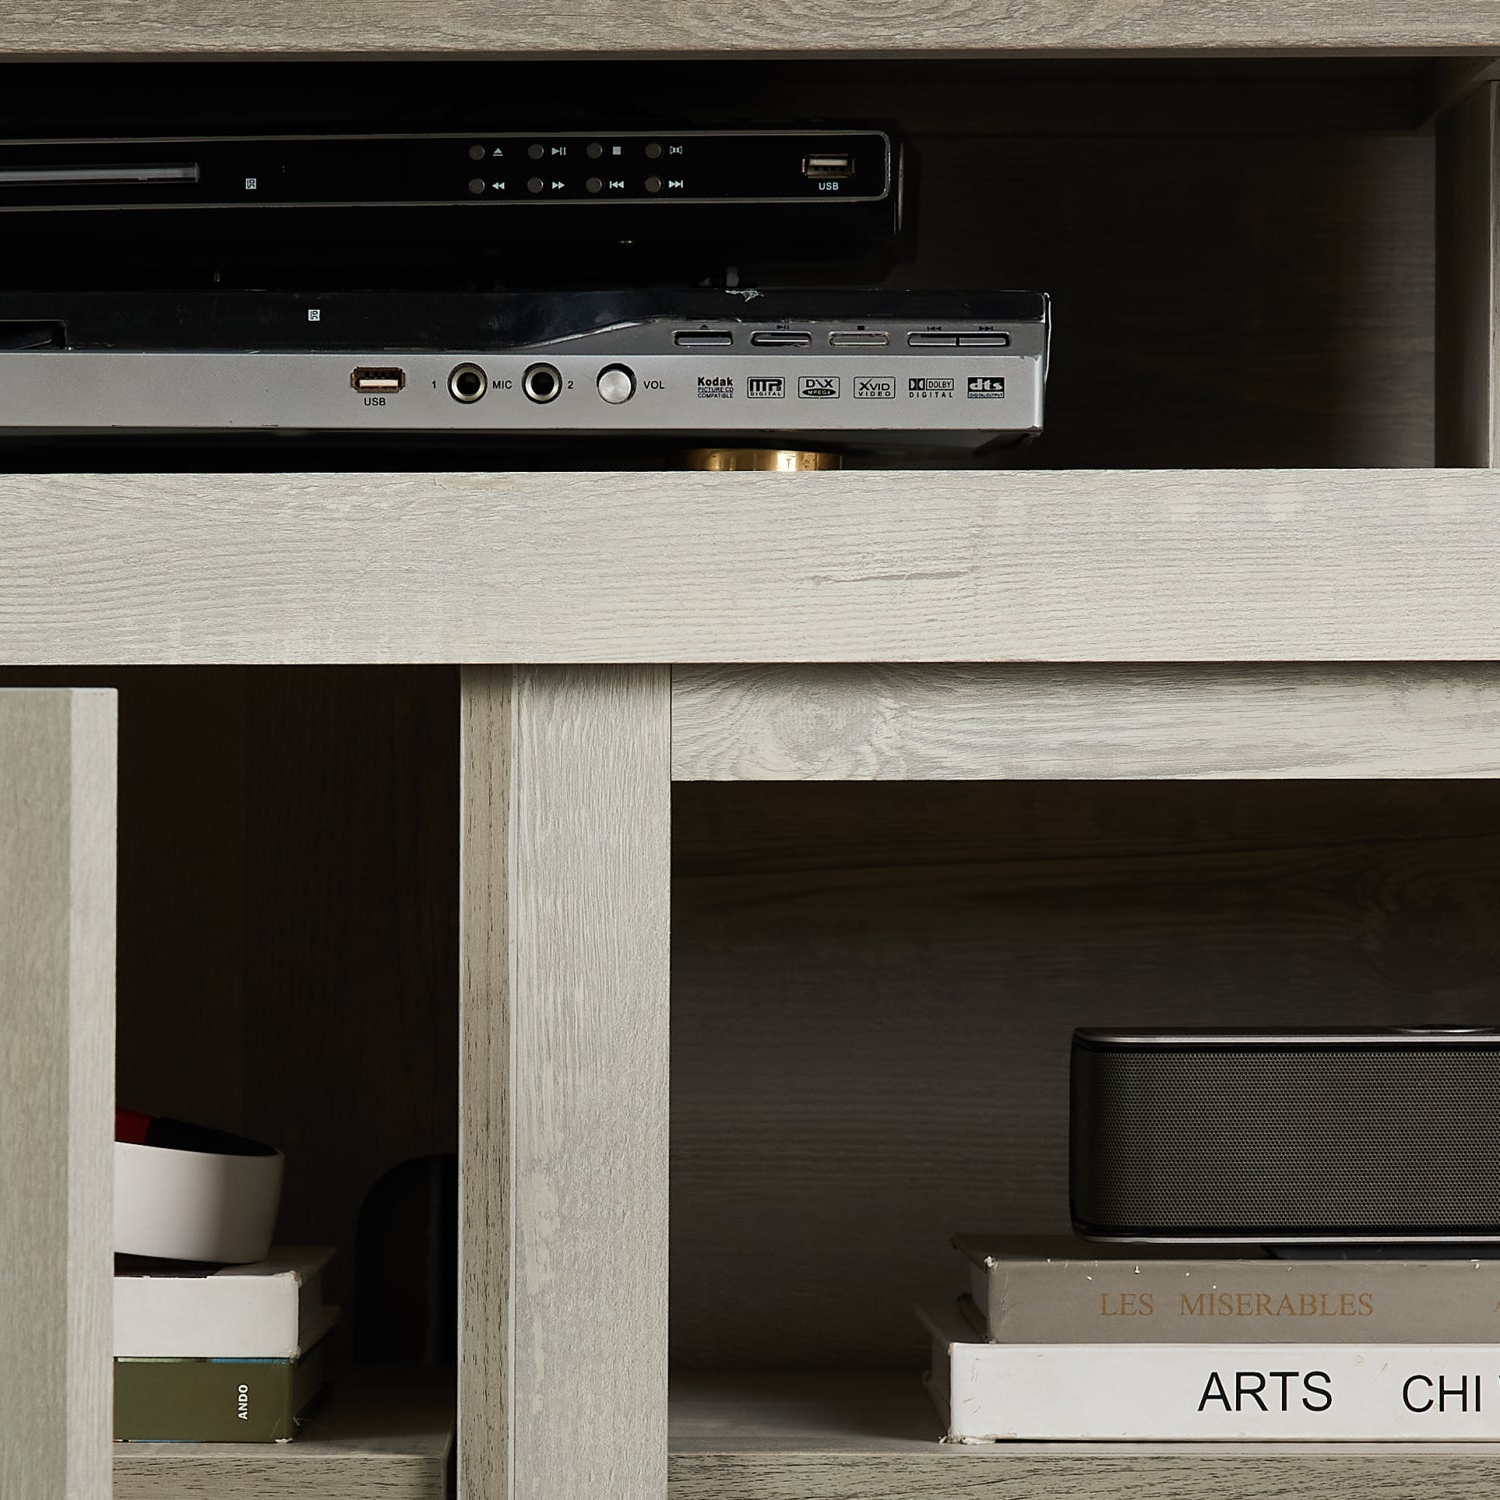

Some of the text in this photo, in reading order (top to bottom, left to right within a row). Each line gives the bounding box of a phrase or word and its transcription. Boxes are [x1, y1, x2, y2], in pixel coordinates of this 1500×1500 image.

[818, 181, 839, 191] USB
[431, 379, 574, 390] 1 MIC 2
[643, 380, 665, 390] VOL
[697, 376, 734, 387] Kodak
[928, 380, 952, 389] DOLBY
[969, 378, 1004, 391] dts
[363, 396, 386, 407] USB
[1100, 1292, 1374, 1317] LES MISERABLES
[1197, 1370, 1481, 1413] ARTS CHI
[237, 1383, 249, 1421] ANDO
